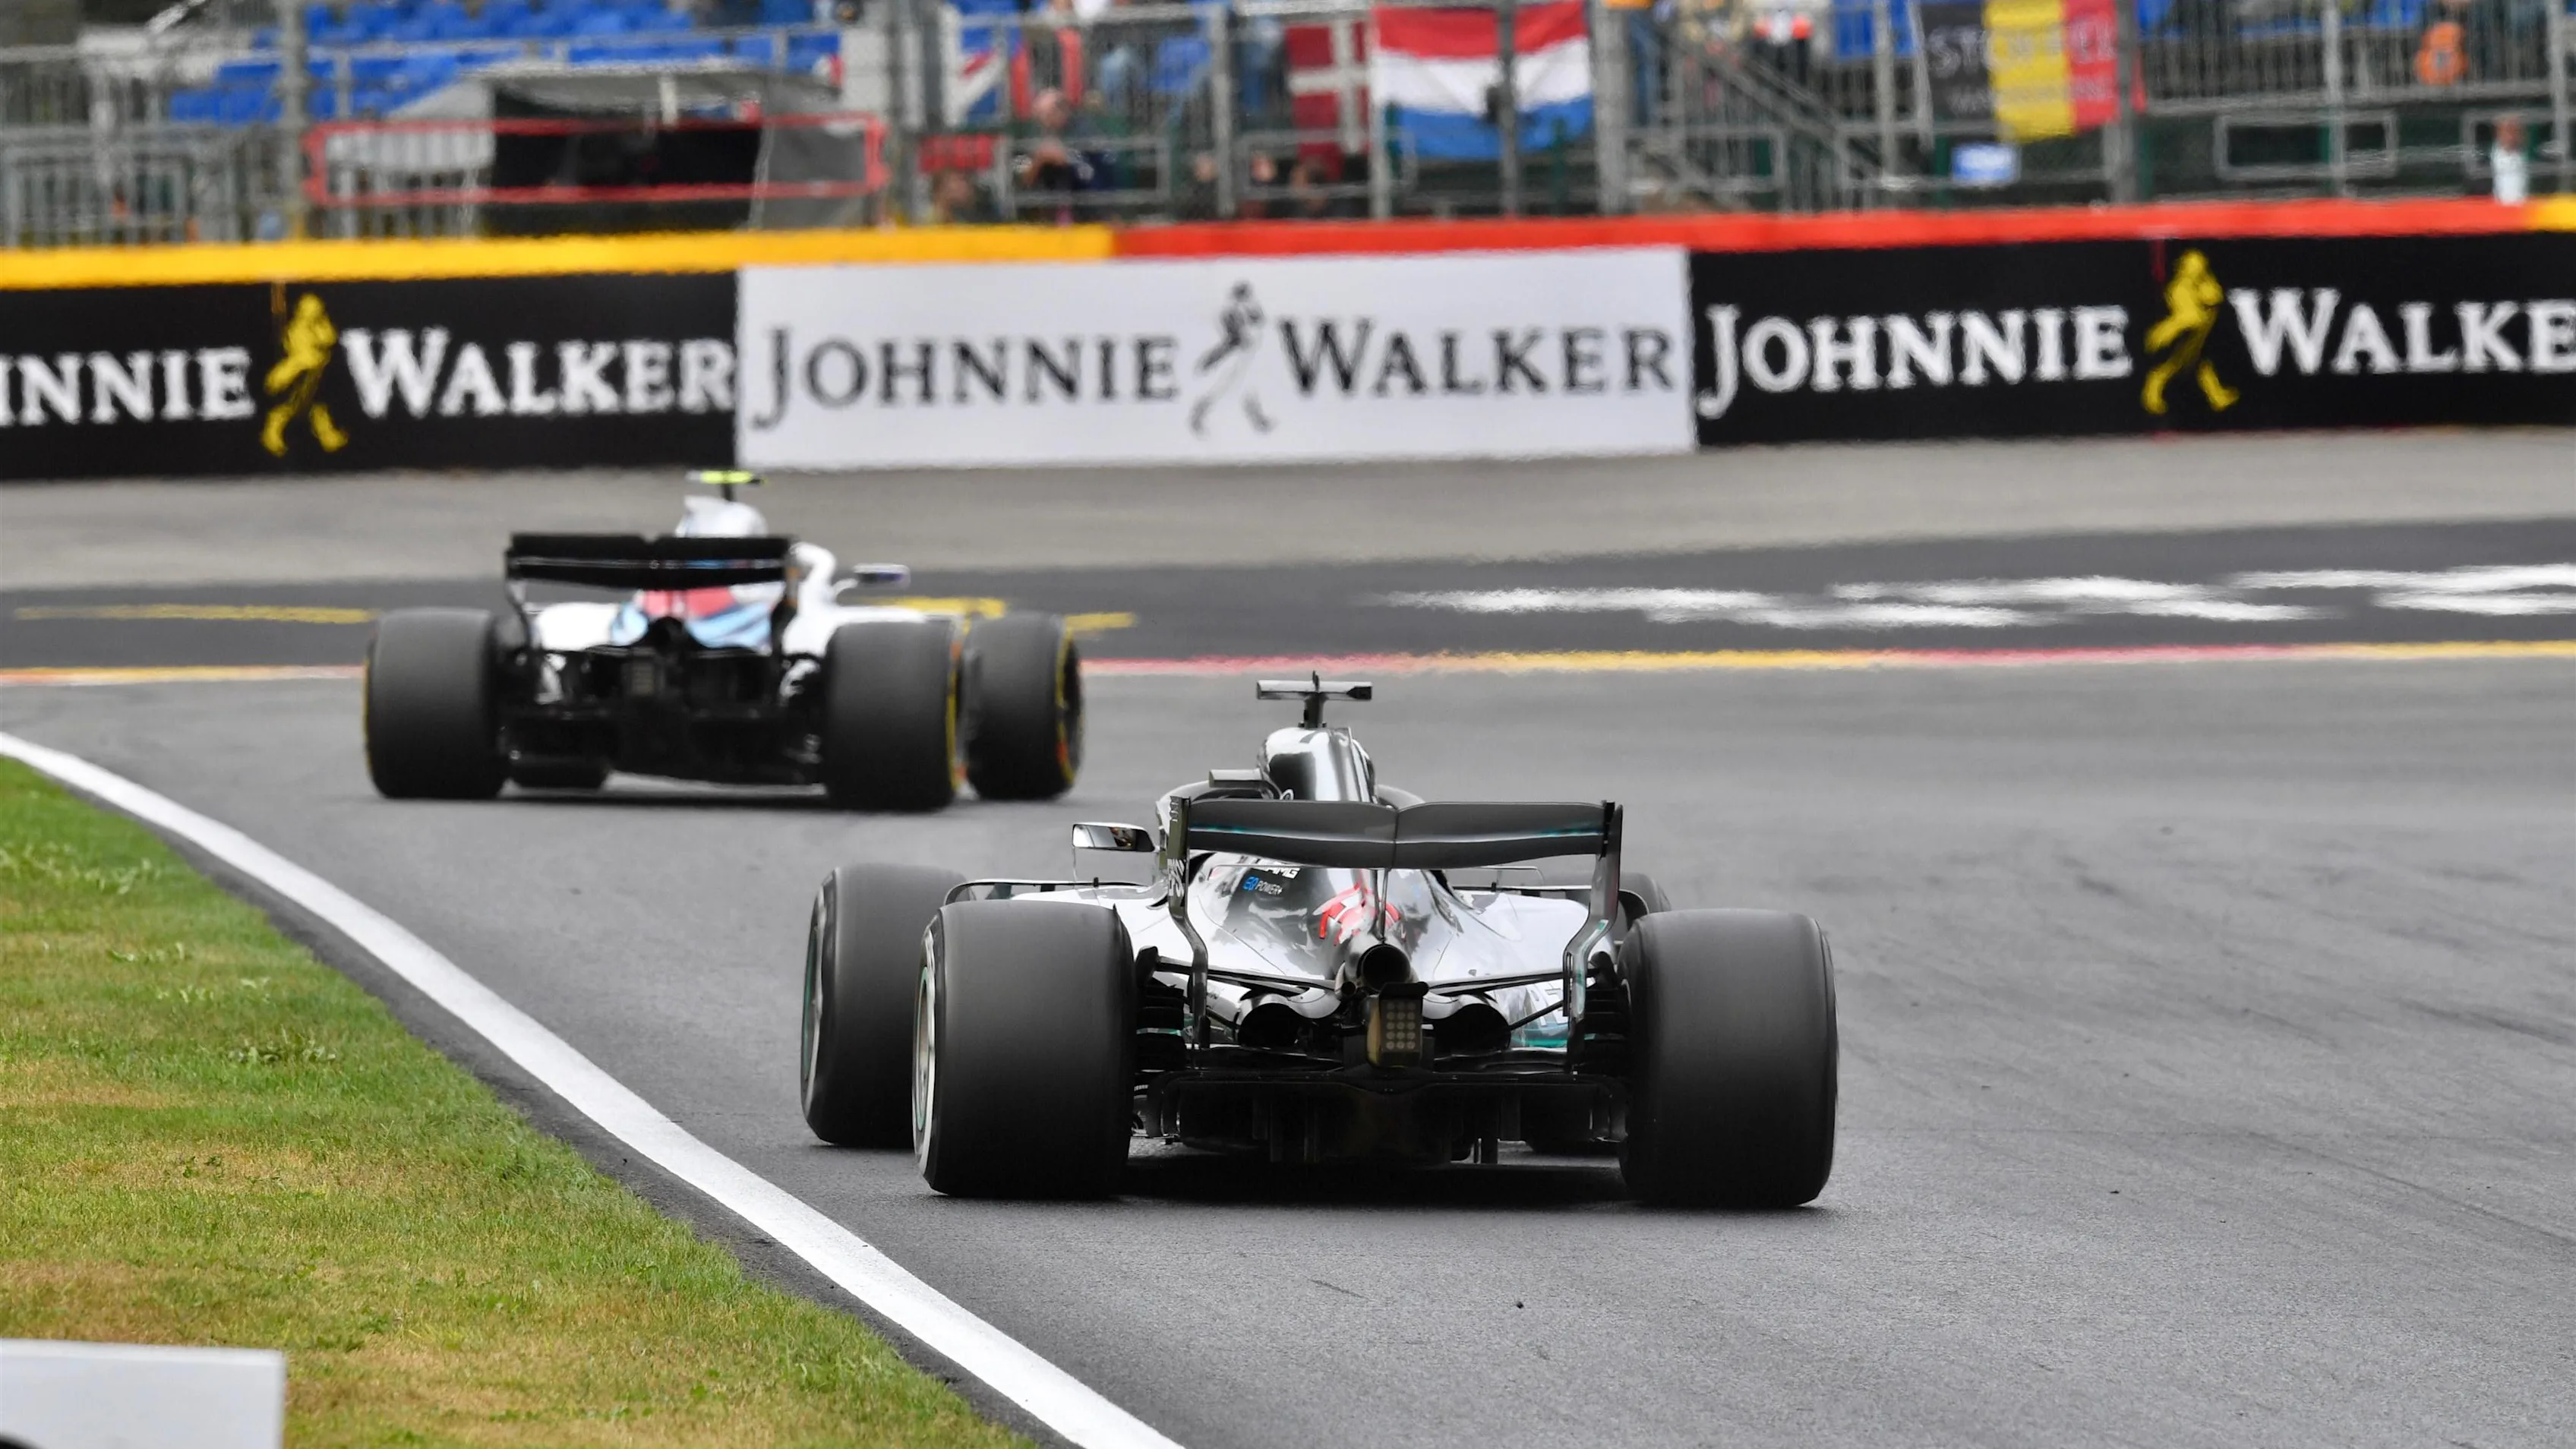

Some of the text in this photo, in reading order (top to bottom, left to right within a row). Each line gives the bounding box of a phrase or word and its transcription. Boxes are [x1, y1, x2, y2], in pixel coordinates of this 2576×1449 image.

[341, 327, 735, 418] WALKER
[752, 317, 1675, 431] JOHNNIE WALKER
[1697, 304, 2132, 418] JOHNNIE
